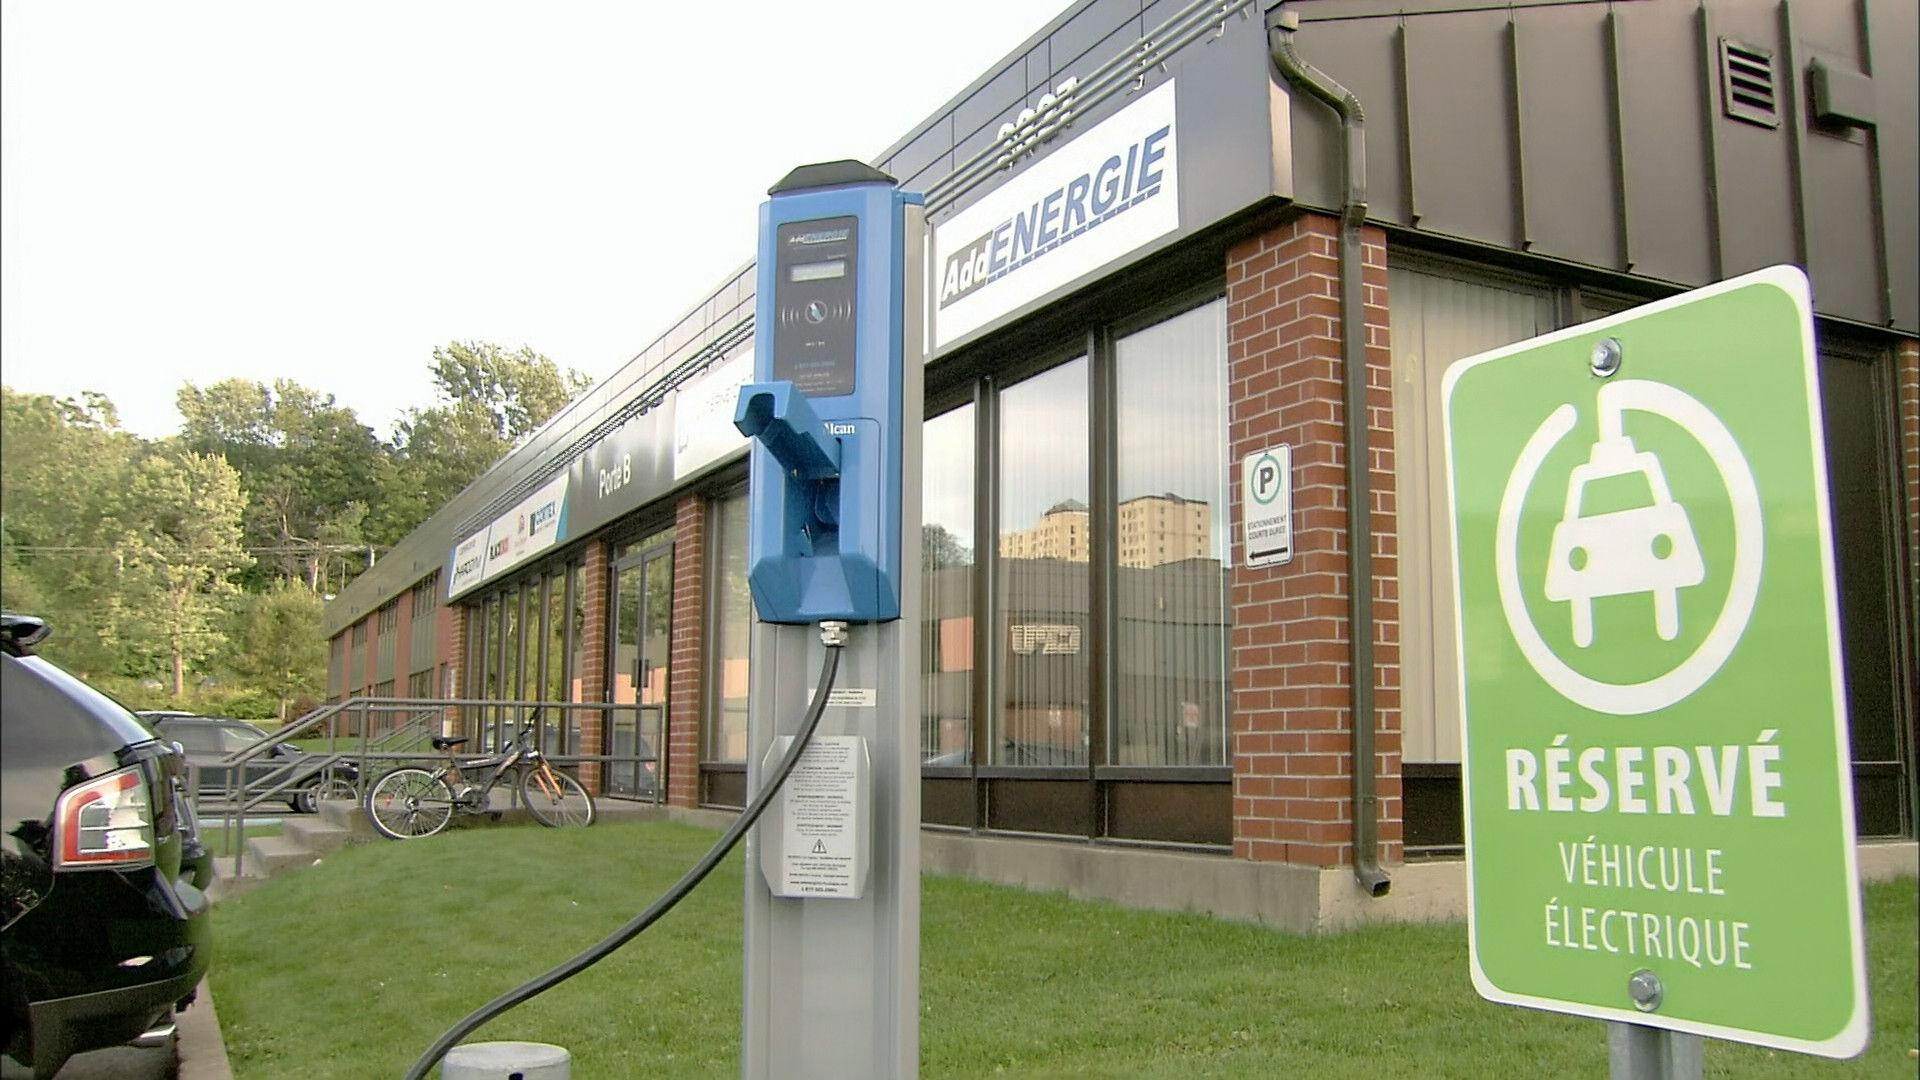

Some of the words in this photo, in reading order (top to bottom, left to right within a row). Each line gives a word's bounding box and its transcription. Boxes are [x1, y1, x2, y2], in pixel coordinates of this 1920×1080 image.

[941, 124, 1171, 306] AddENERGIE
[599, 463, 622, 499] Porte
[623, 453, 632, 486] B
[1260, 466, 1274, 494] P
[1505, 728, 1787, 818] RÉSERVÉ
[1558, 835, 1726, 896] VÉHICULE
[1544, 896, 1753, 970] ÉLECTRIQUE
